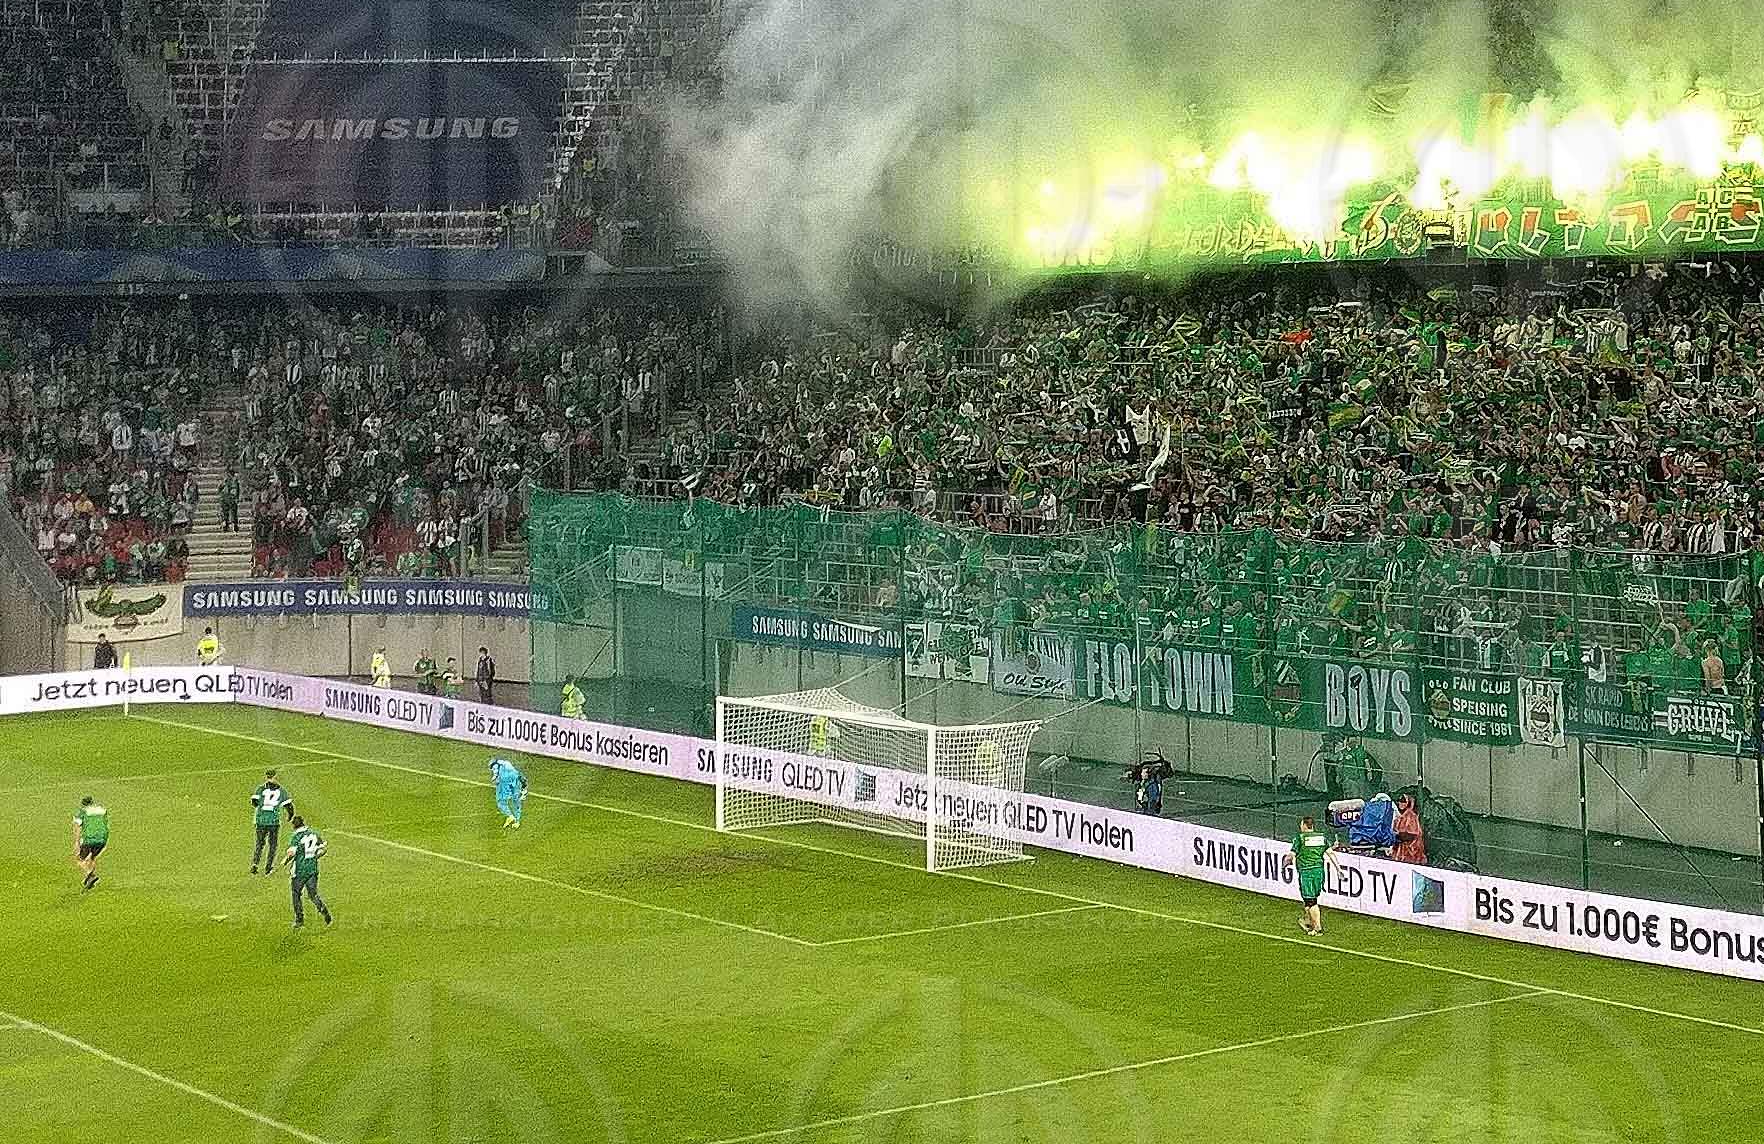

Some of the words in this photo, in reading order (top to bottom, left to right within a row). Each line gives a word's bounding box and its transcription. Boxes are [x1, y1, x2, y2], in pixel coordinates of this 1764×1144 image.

[261, 116, 521, 140] SAMSUNG
[192, 589, 295, 609] SAMSUNG
[304, 588, 398, 606] SAMSUNG
[405, 588, 483, 606] SAMSUNG
[488, 591, 549, 610] SAMSUNG
[752, 615, 808, 639] SAMSUNG
[32, 677, 98, 703] Jetzt
[105, 675, 187, 696] neuen
[247, 675, 260, 690] TV
[260, 677, 293, 702] holen
[1452, 676, 1476, 692] FAN
[1481, 678, 1511, 694] CLUB
[1325, 662, 1412, 737] BOYS
[1452, 697, 1508, 717] SPEISING
[325, 687, 380, 716] SAMSUNG
[387, 696, 417, 723] QLED
[418, 703, 433, 725] TV
[467, 708, 486, 734] Bis
[487, 717, 505, 737] zu
[507, 717, 547, 744] 1.000€
[550, 723, 593, 753] Bonus
[596, 731, 669, 766] kassieren
[1452, 719, 1487, 736] SINCE
[782, 762, 824, 792] QLED
[826, 770, 846, 795] TV
[1052, 809, 1077, 838] TV
[1079, 815, 1134, 852] holen
[1193, 836, 1294, 884] SAMSUNG
[1321, 861, 1363, 898] LED
[1368, 870, 1397, 905] TV
[1475, 887, 1515, 924] Bis
[1522, 900, 1558, 933] zu
[1566, 901, 1660, 949] 1.000€
